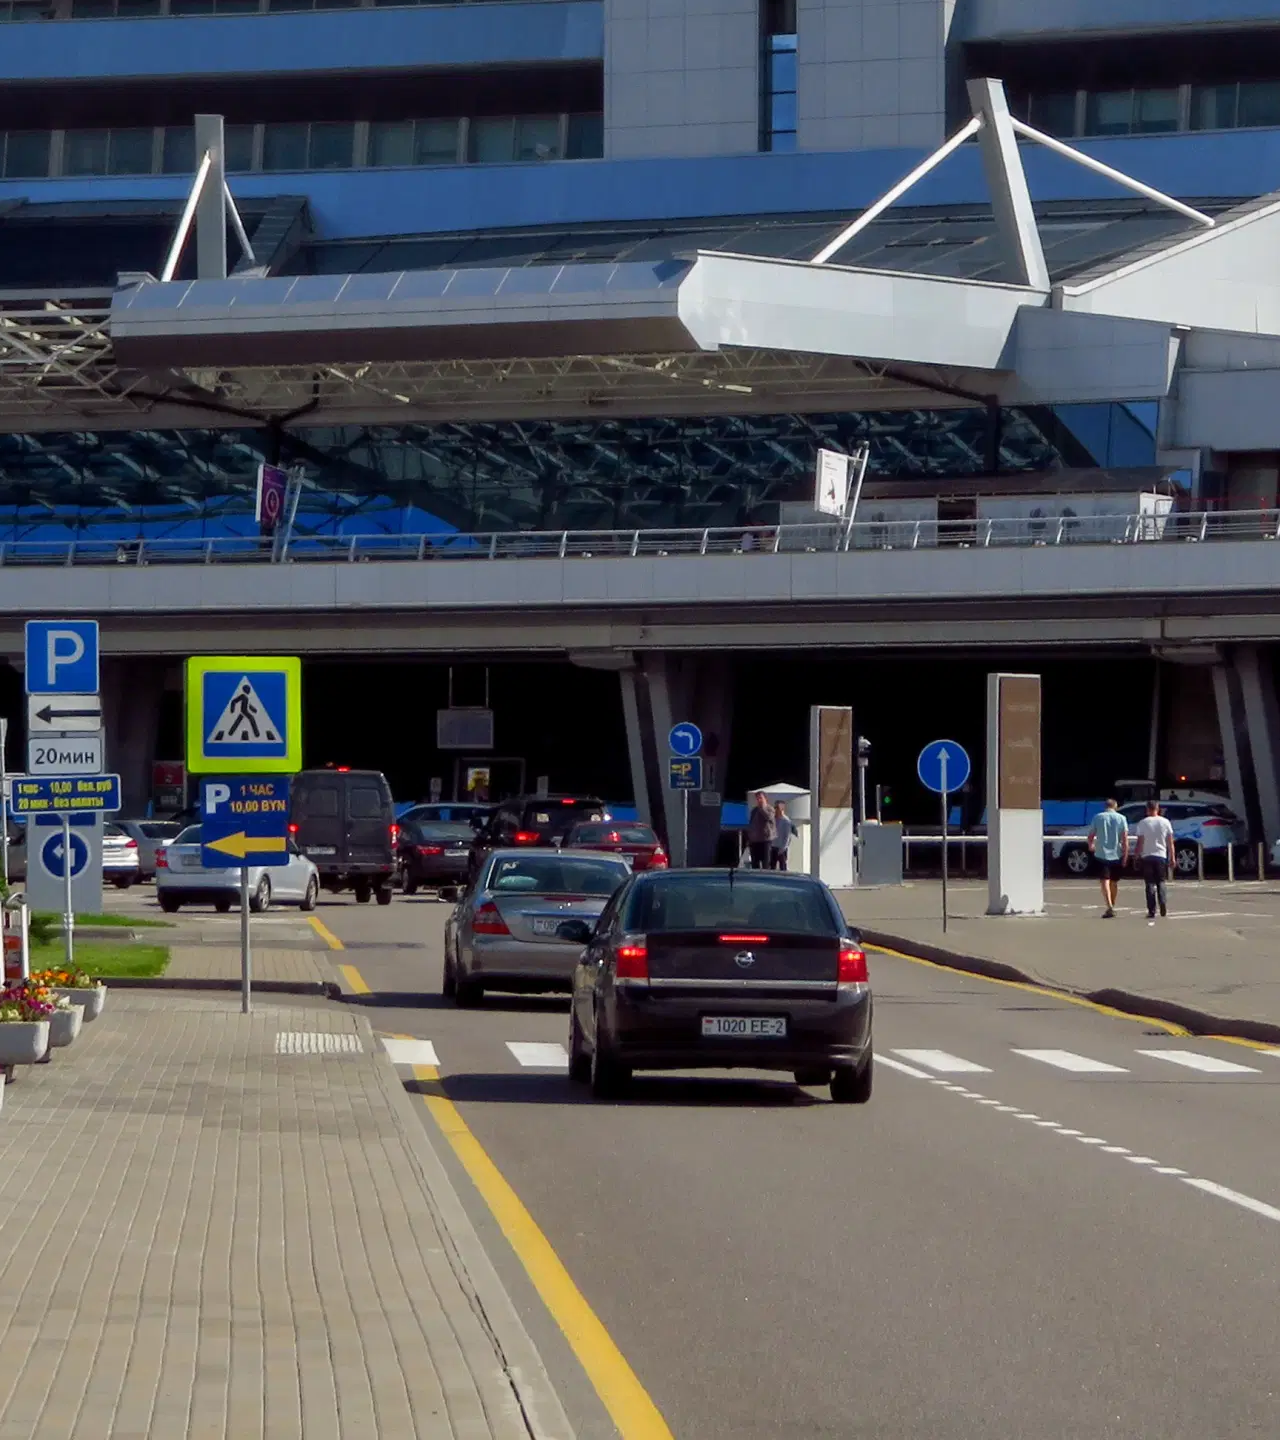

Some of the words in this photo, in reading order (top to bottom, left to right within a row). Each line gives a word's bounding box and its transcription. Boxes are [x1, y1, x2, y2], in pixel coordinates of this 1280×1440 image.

[47, 630, 85, 685] P
[34, 748, 95, 765] 20мин
[249, 784, 274, 795] ЧАС
[18, 798, 29, 809] 20
[205, 784, 231, 814] P
[231, 800, 258, 813] 10,00
[261, 800, 286, 812] BYN
[716, 1019, 746, 1033] 1020
[751, 1019, 783, 1034] EE-2
